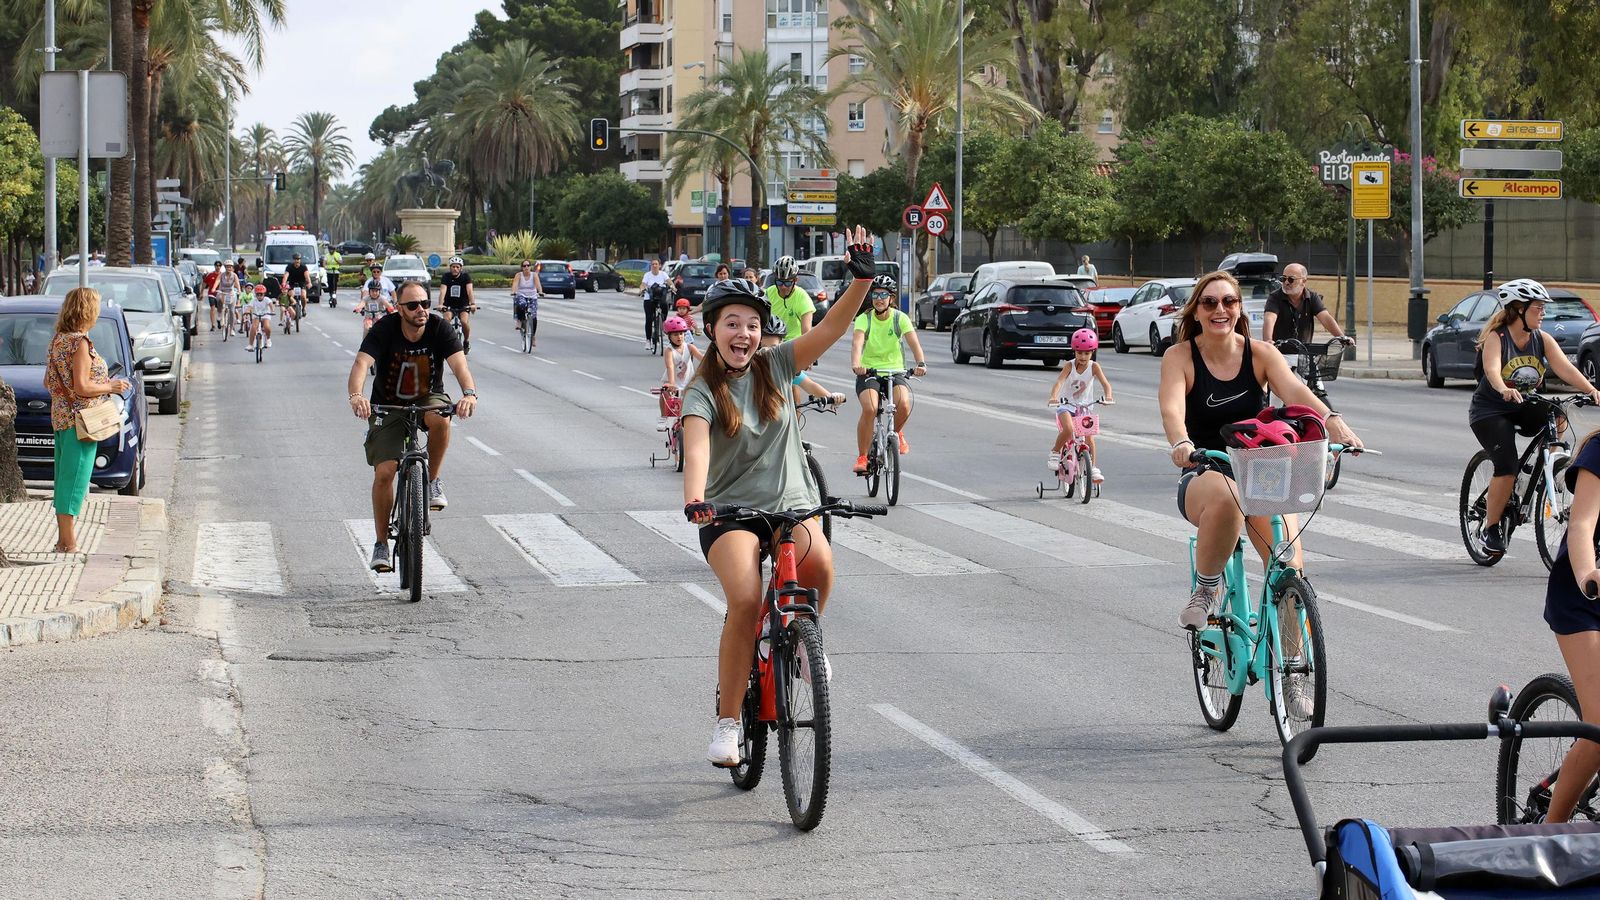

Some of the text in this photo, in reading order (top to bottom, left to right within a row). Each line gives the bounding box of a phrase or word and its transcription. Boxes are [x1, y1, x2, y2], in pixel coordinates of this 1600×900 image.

[1319, 149, 1390, 163] Restaurante
[1324, 165, 1335, 180] El
[1503, 182, 1558, 195] Alcampo
[929, 221, 942, 229] 30
